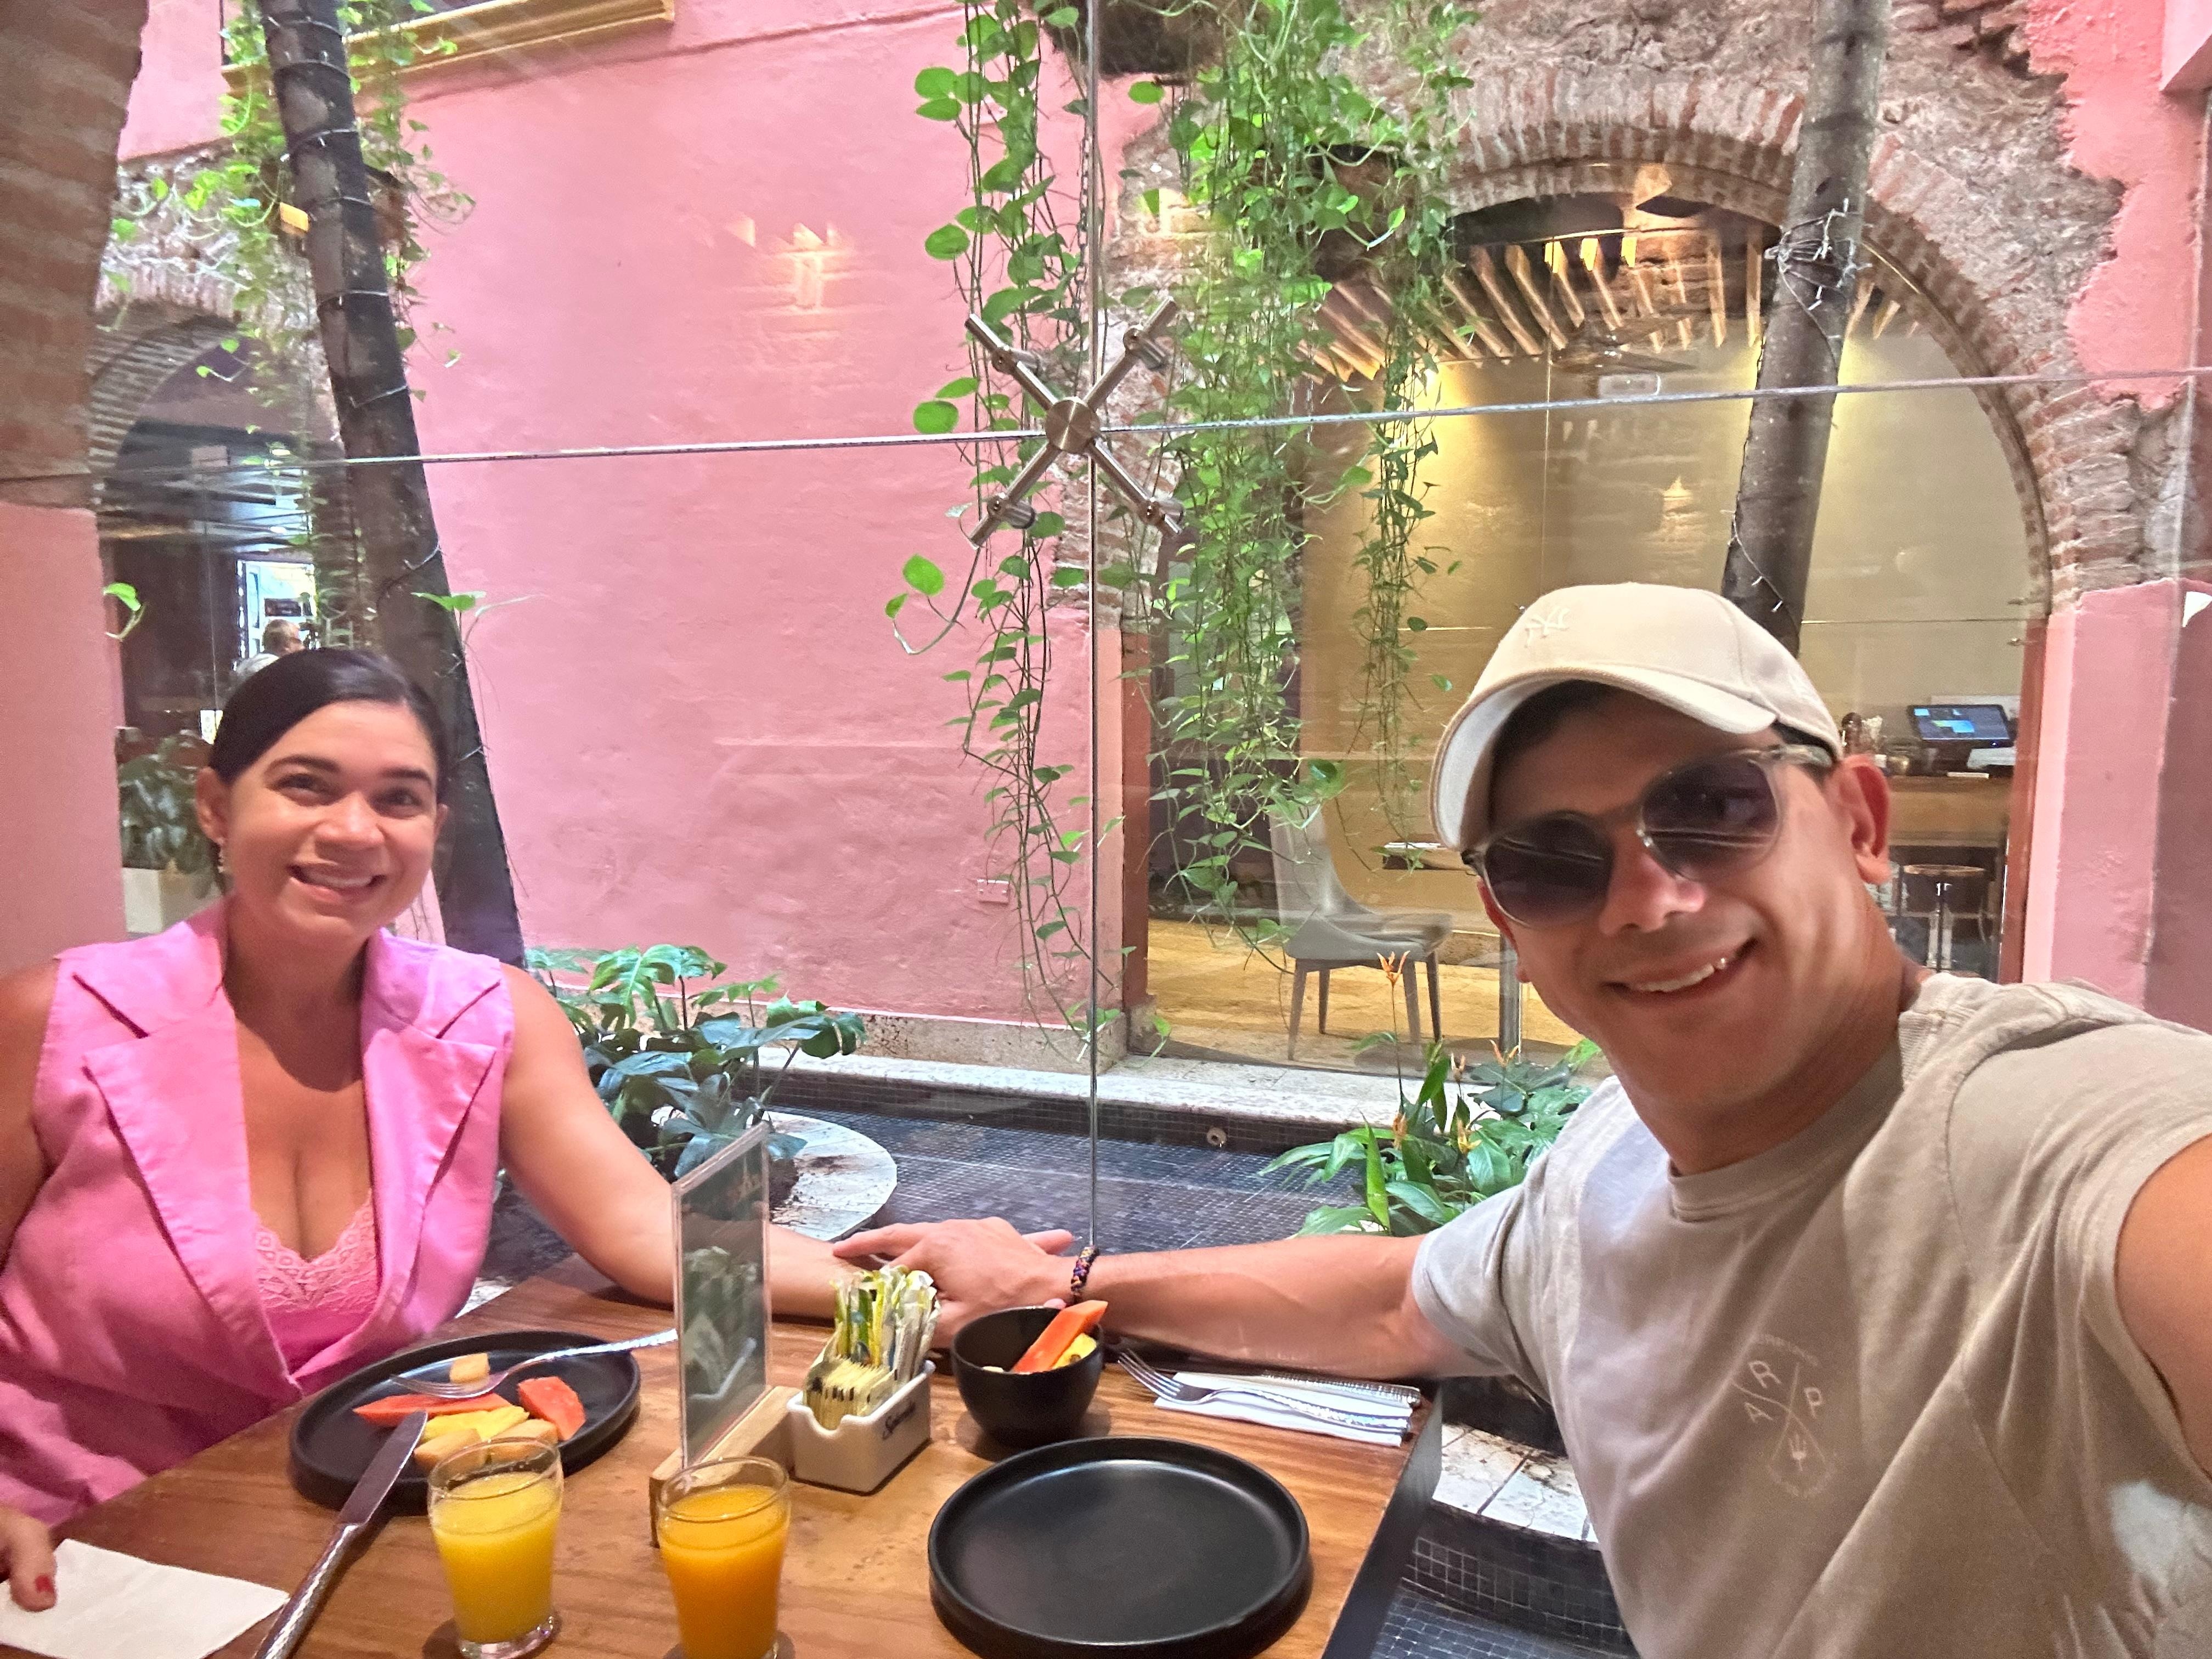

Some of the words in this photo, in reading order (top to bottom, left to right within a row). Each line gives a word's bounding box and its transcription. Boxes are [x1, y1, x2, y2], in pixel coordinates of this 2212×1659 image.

[1748, 1360, 1782, 1389] R
[1744, 1402, 1774, 1424] A
[1803, 1386, 1824, 1419] P
